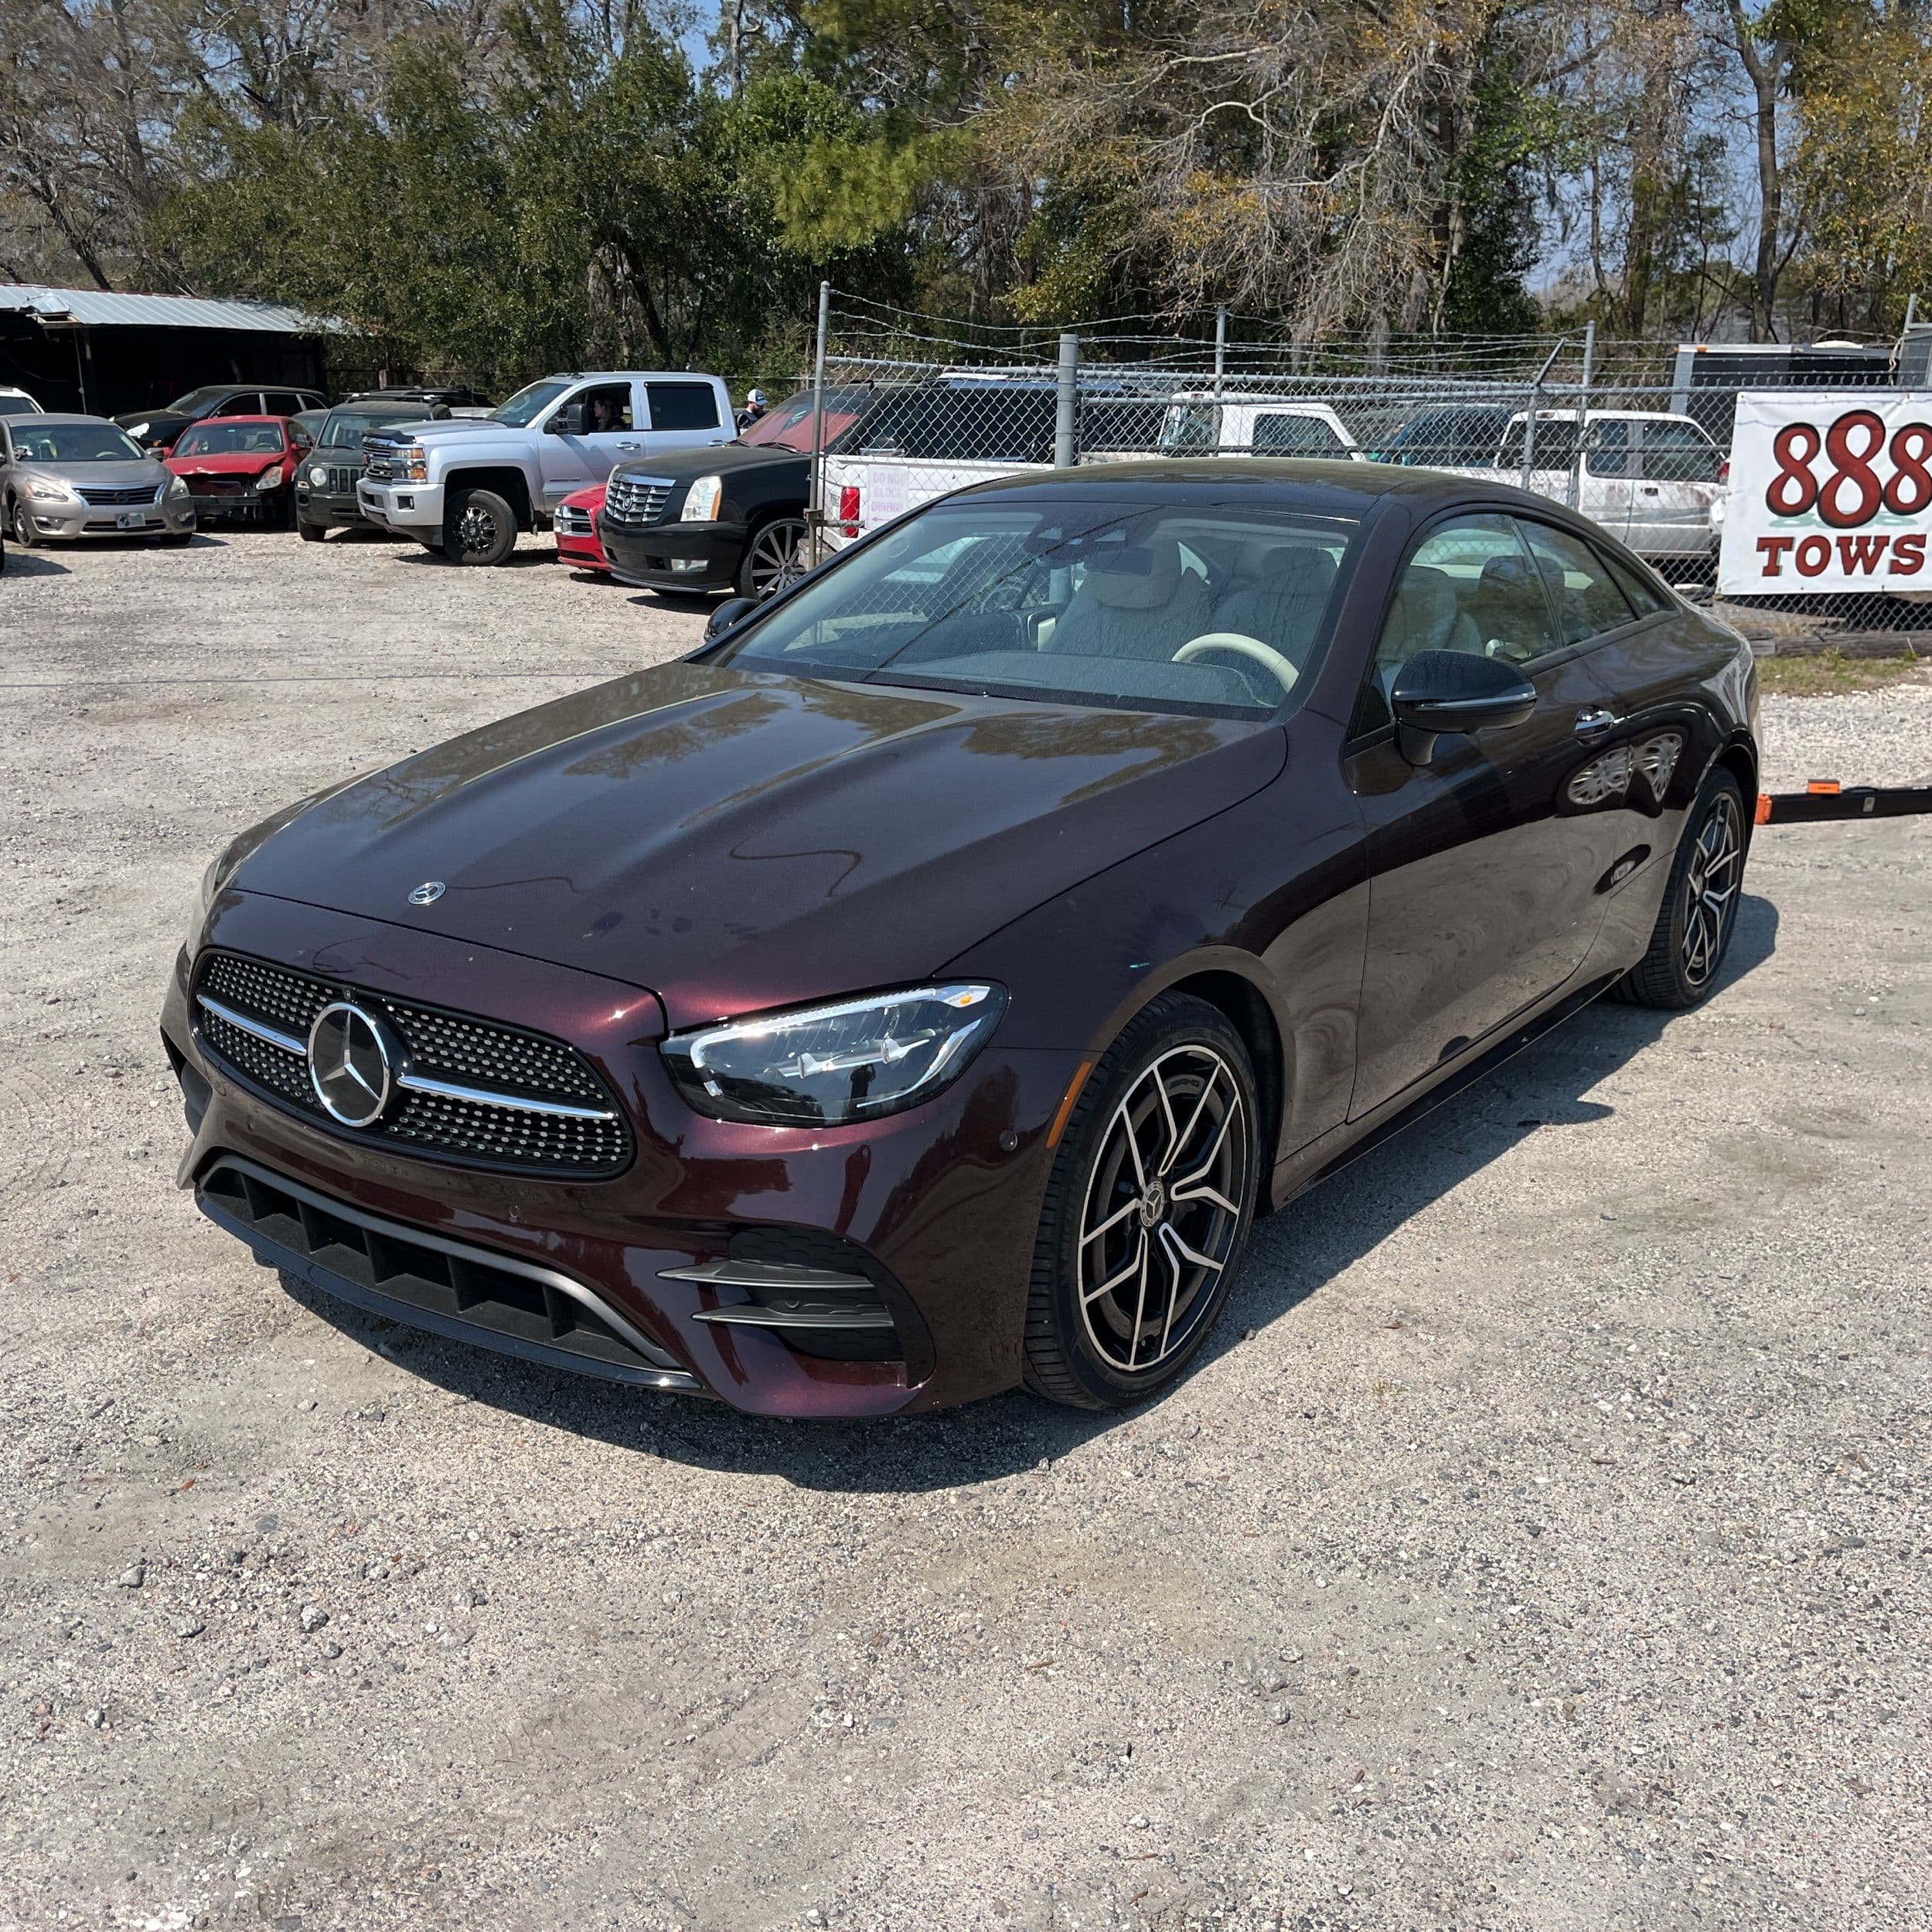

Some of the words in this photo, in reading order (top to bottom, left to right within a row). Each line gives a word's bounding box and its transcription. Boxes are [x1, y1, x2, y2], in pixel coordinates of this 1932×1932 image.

[1765, 409, 1932, 529] 888
[873, 472, 885, 483] DO
[874, 487, 902, 498] BLOCK
[871, 501, 904, 513] DRIVEWAY
[1756, 533, 1927, 577] TOWS
